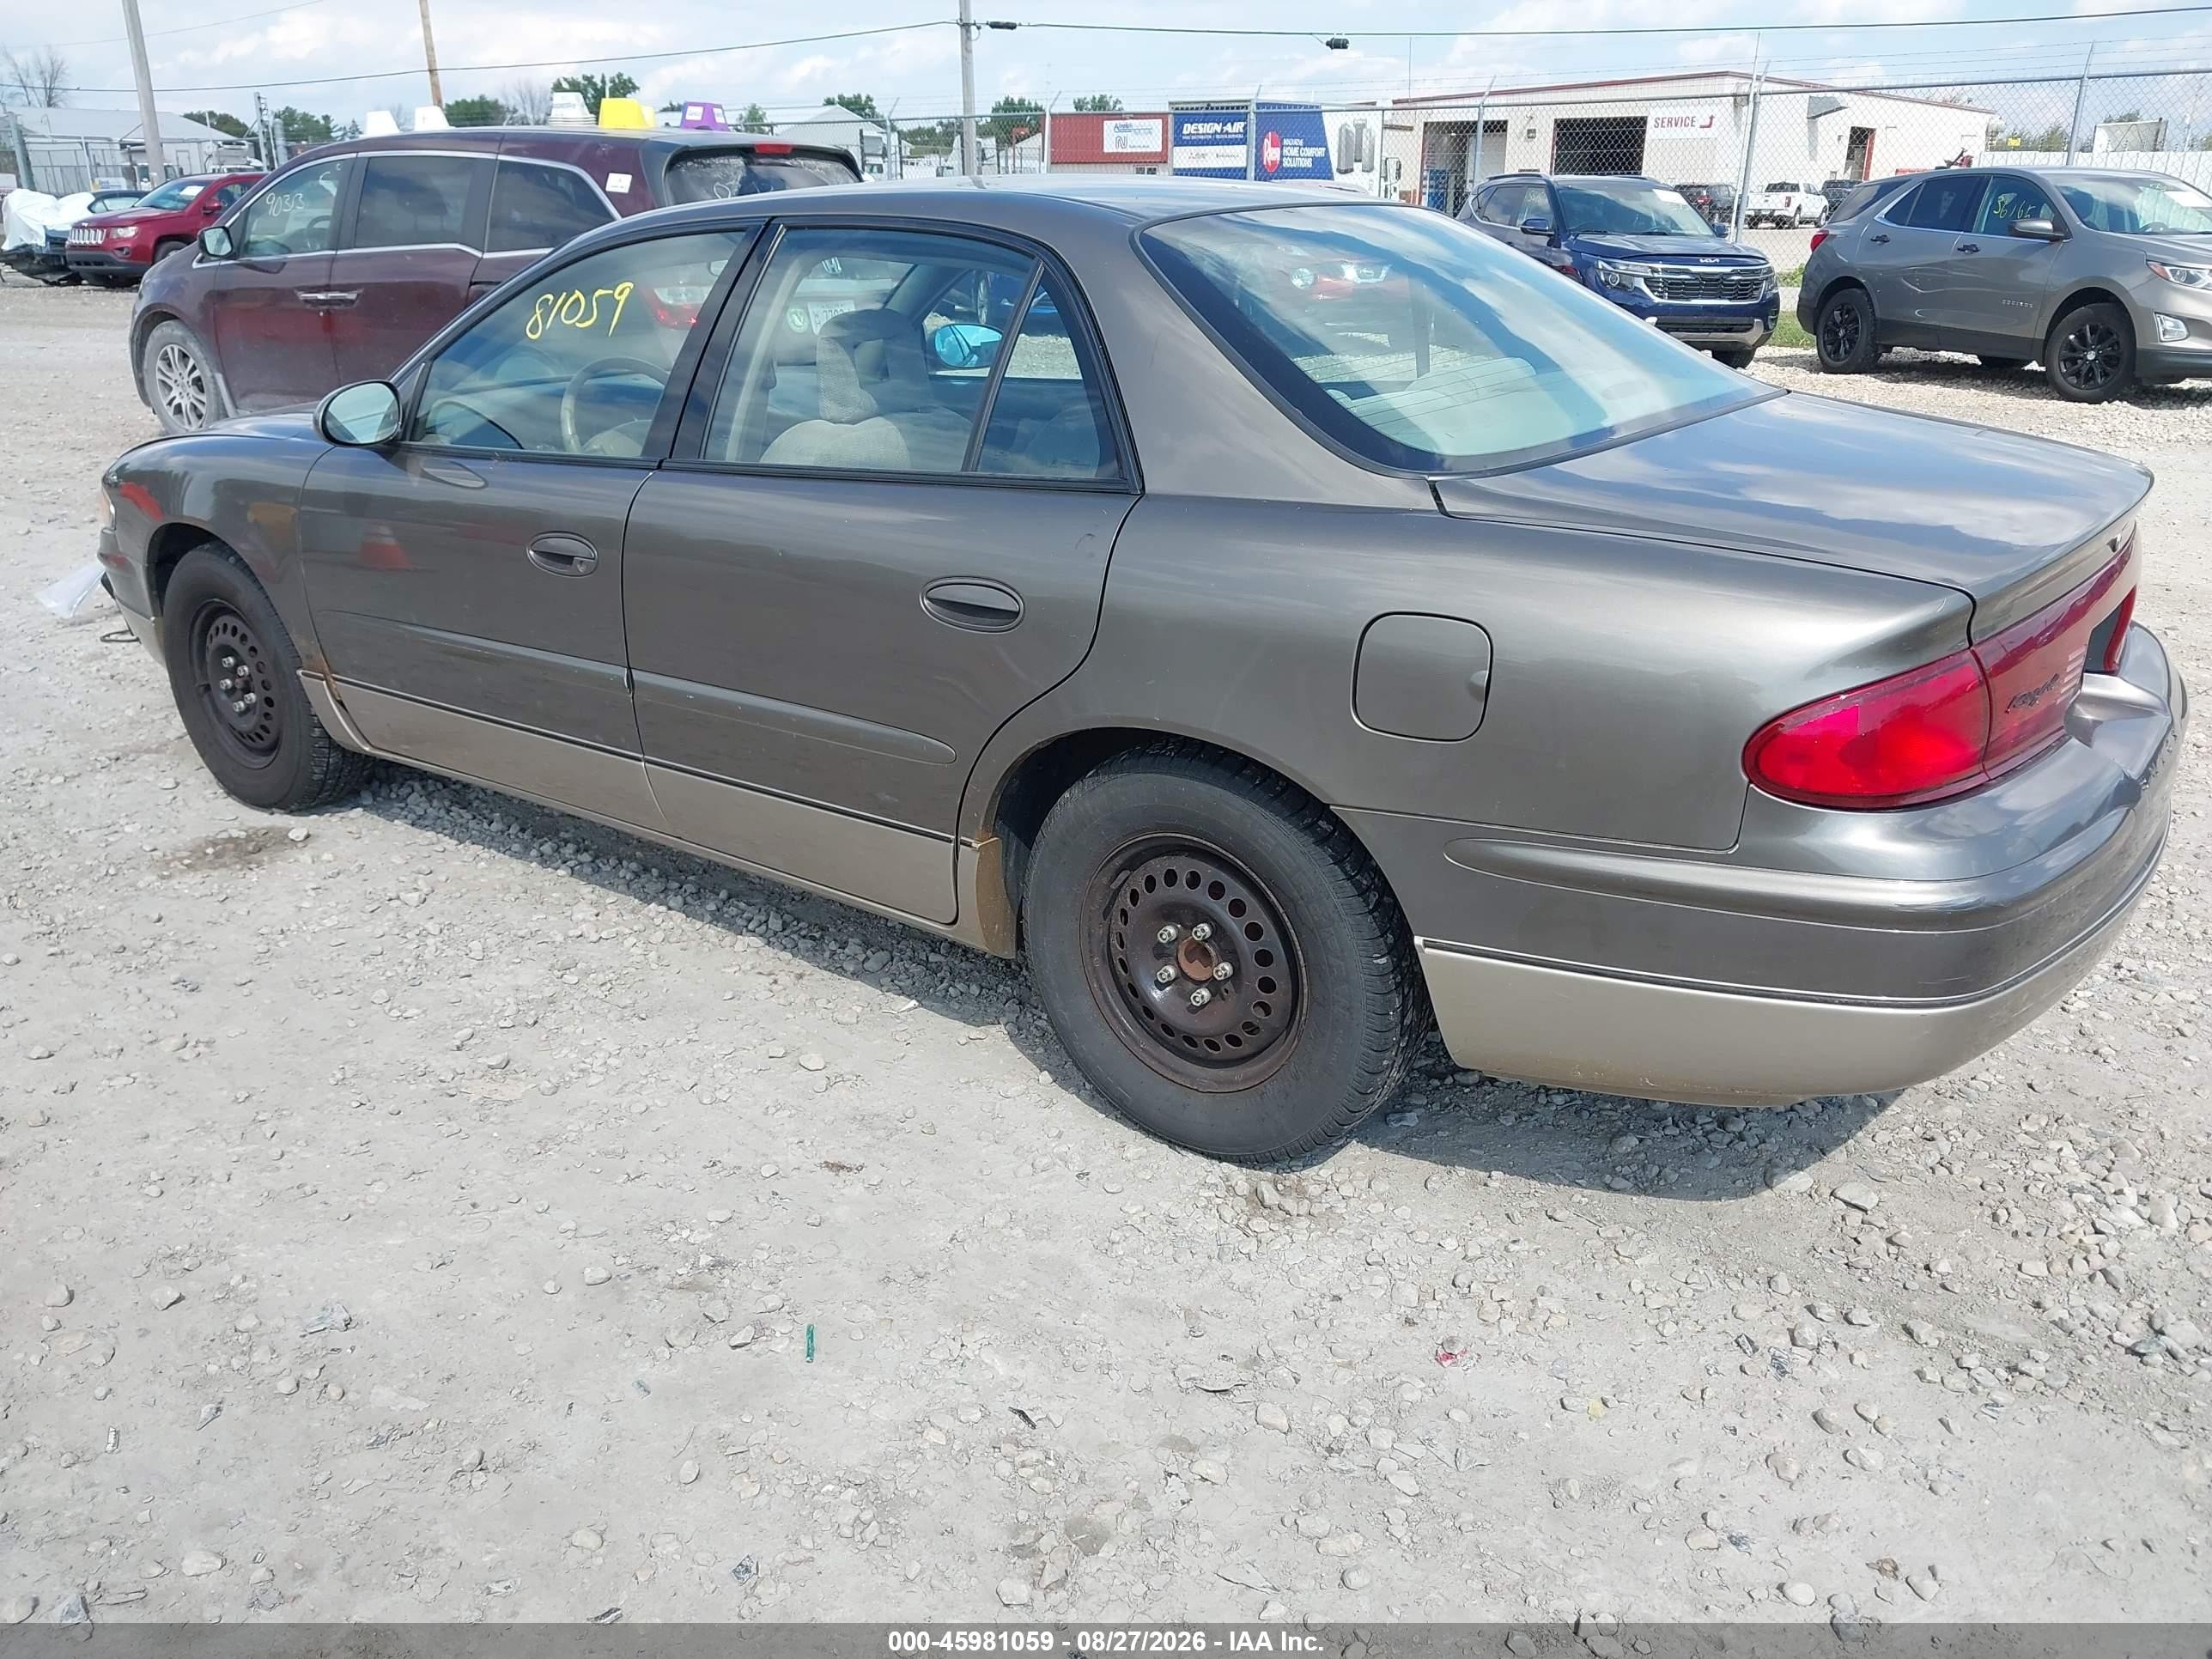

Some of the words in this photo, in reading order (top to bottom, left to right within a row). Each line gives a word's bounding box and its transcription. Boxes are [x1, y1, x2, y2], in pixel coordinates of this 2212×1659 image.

[1182, 122, 1222, 134] DESIGN
[1222, 121, 1245, 133] AIR
[1654, 116, 1697, 129] SERVICE
[1283, 146, 1299, 157] HOME
[1300, 147, 1326, 158] COMFORT
[1282, 157, 1313, 167] SOLUTIONS
[525, 281, 635, 340] 81059
